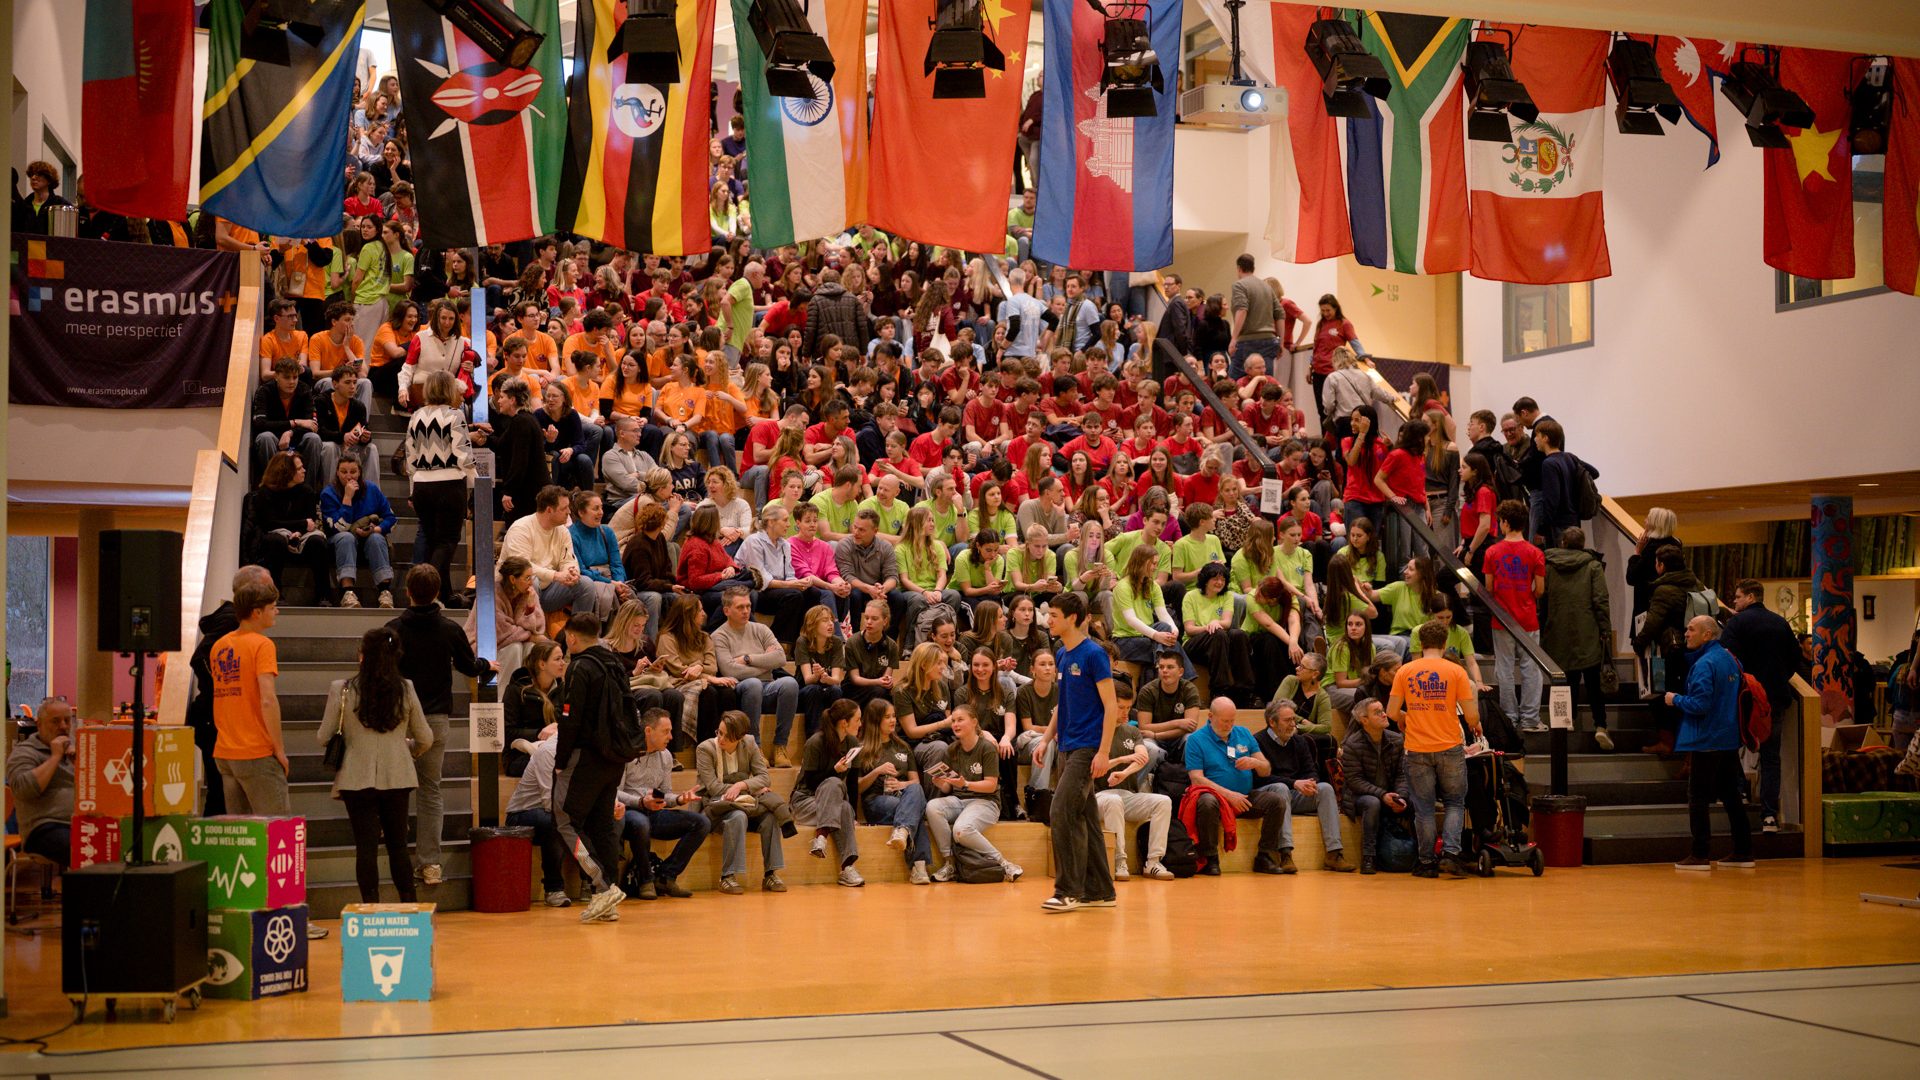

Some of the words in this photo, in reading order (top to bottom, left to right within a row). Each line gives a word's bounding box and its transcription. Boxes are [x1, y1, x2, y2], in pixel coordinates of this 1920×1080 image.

[65, 323, 101, 335] meer
[106, 323, 182, 340] perspectief
[67, 386, 148, 396] www.erasmusplus.nl
[1422, 680, 1447, 690] Global
[157, 733, 164, 753] 2
[79, 801, 96, 811] 9
[191, 825, 201, 845] 3
[204, 826, 223, 834] GOOD
[224, 826, 248, 834] HEALTH
[295, 822, 304, 841] 10
[204, 837, 219, 846] AND
[220, 837, 257, 846] WELL-BEING
[363, 917, 385, 926] CLEAN
[386, 917, 409, 926] WATER
[347, 917, 359, 937] 6
[363, 928, 377, 937] AND
[379, 928, 419, 937] SANITATION
